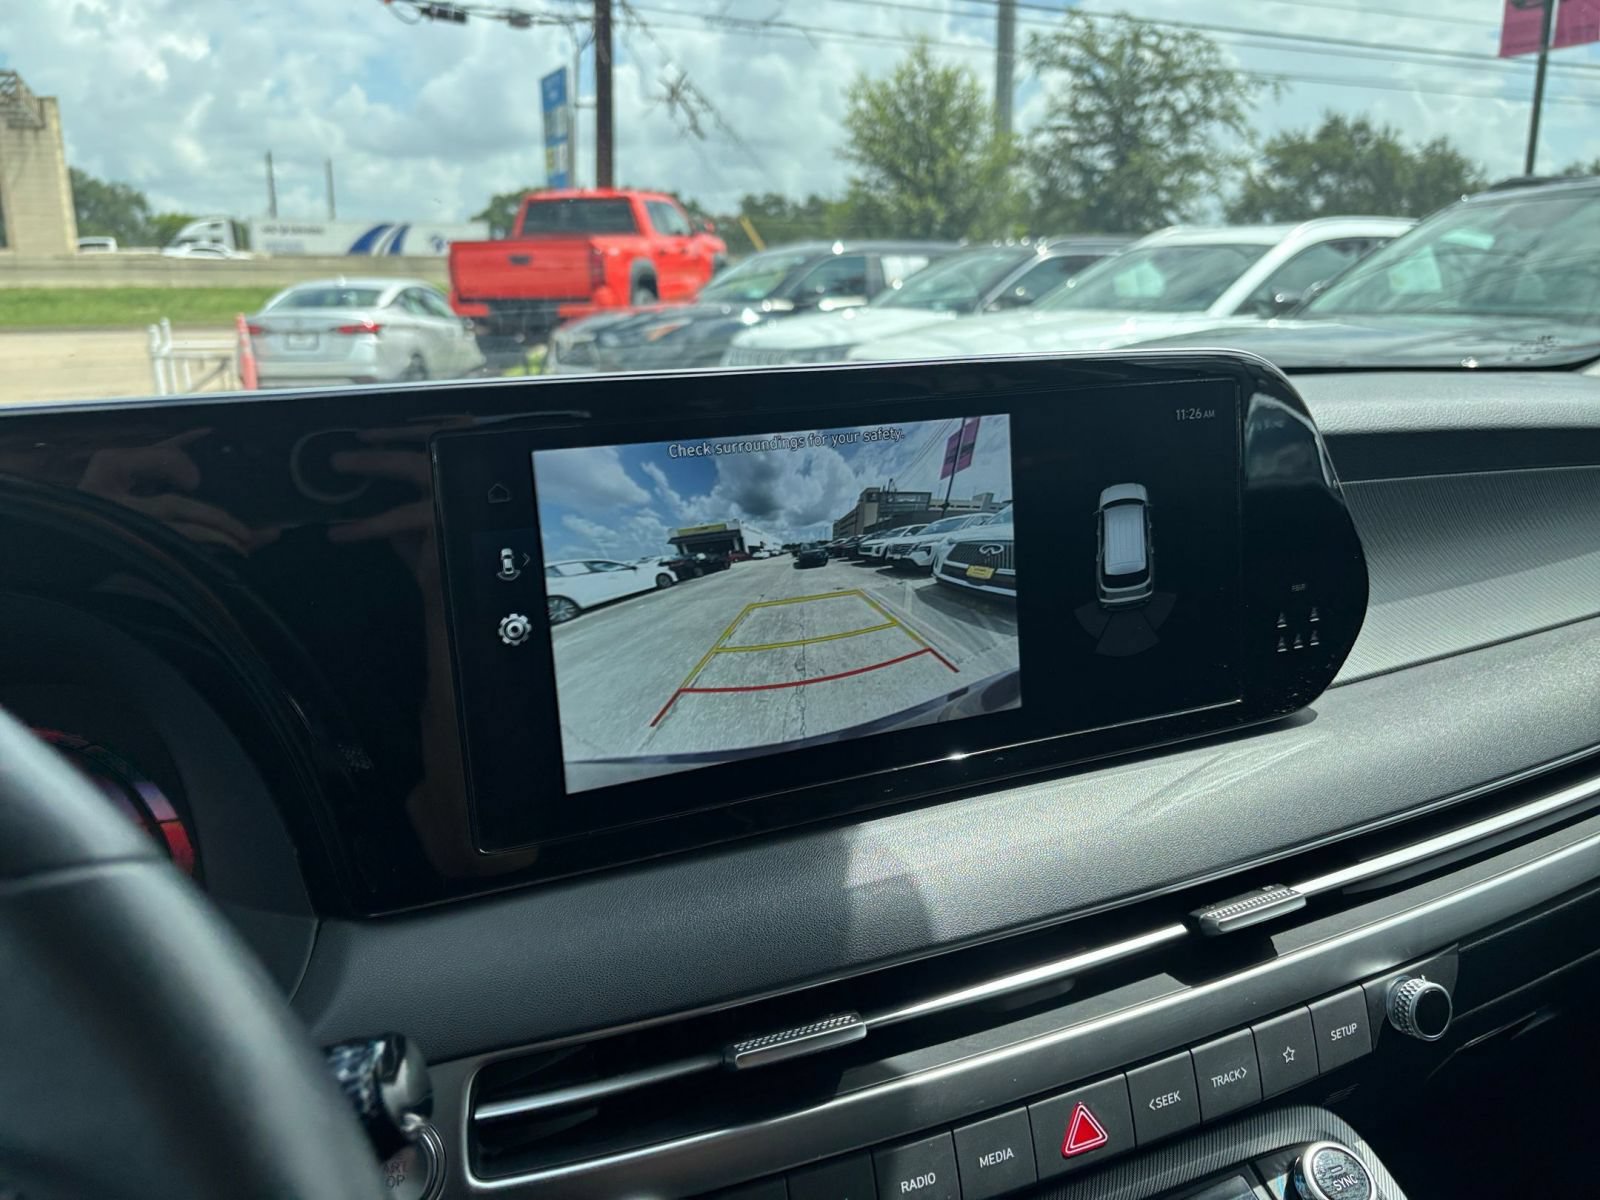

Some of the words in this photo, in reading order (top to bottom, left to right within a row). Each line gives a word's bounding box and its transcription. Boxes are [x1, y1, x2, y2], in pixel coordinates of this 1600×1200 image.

[1176, 408, 1202, 421] 11:26
[1203, 409, 1216, 418] AM
[668, 442, 712, 458] Check
[715, 435, 805, 455] surroundings
[808, 433, 828, 447] for
[831, 430, 860, 448] your
[863, 427, 905, 442] safety.
[1330, 1022, 1358, 1041] SETUP
[979, 1147, 1015, 1169] MEDIA
[900, 1172, 936, 1194] RADIO
[1333, 1174, 1358, 1191] SYNC
